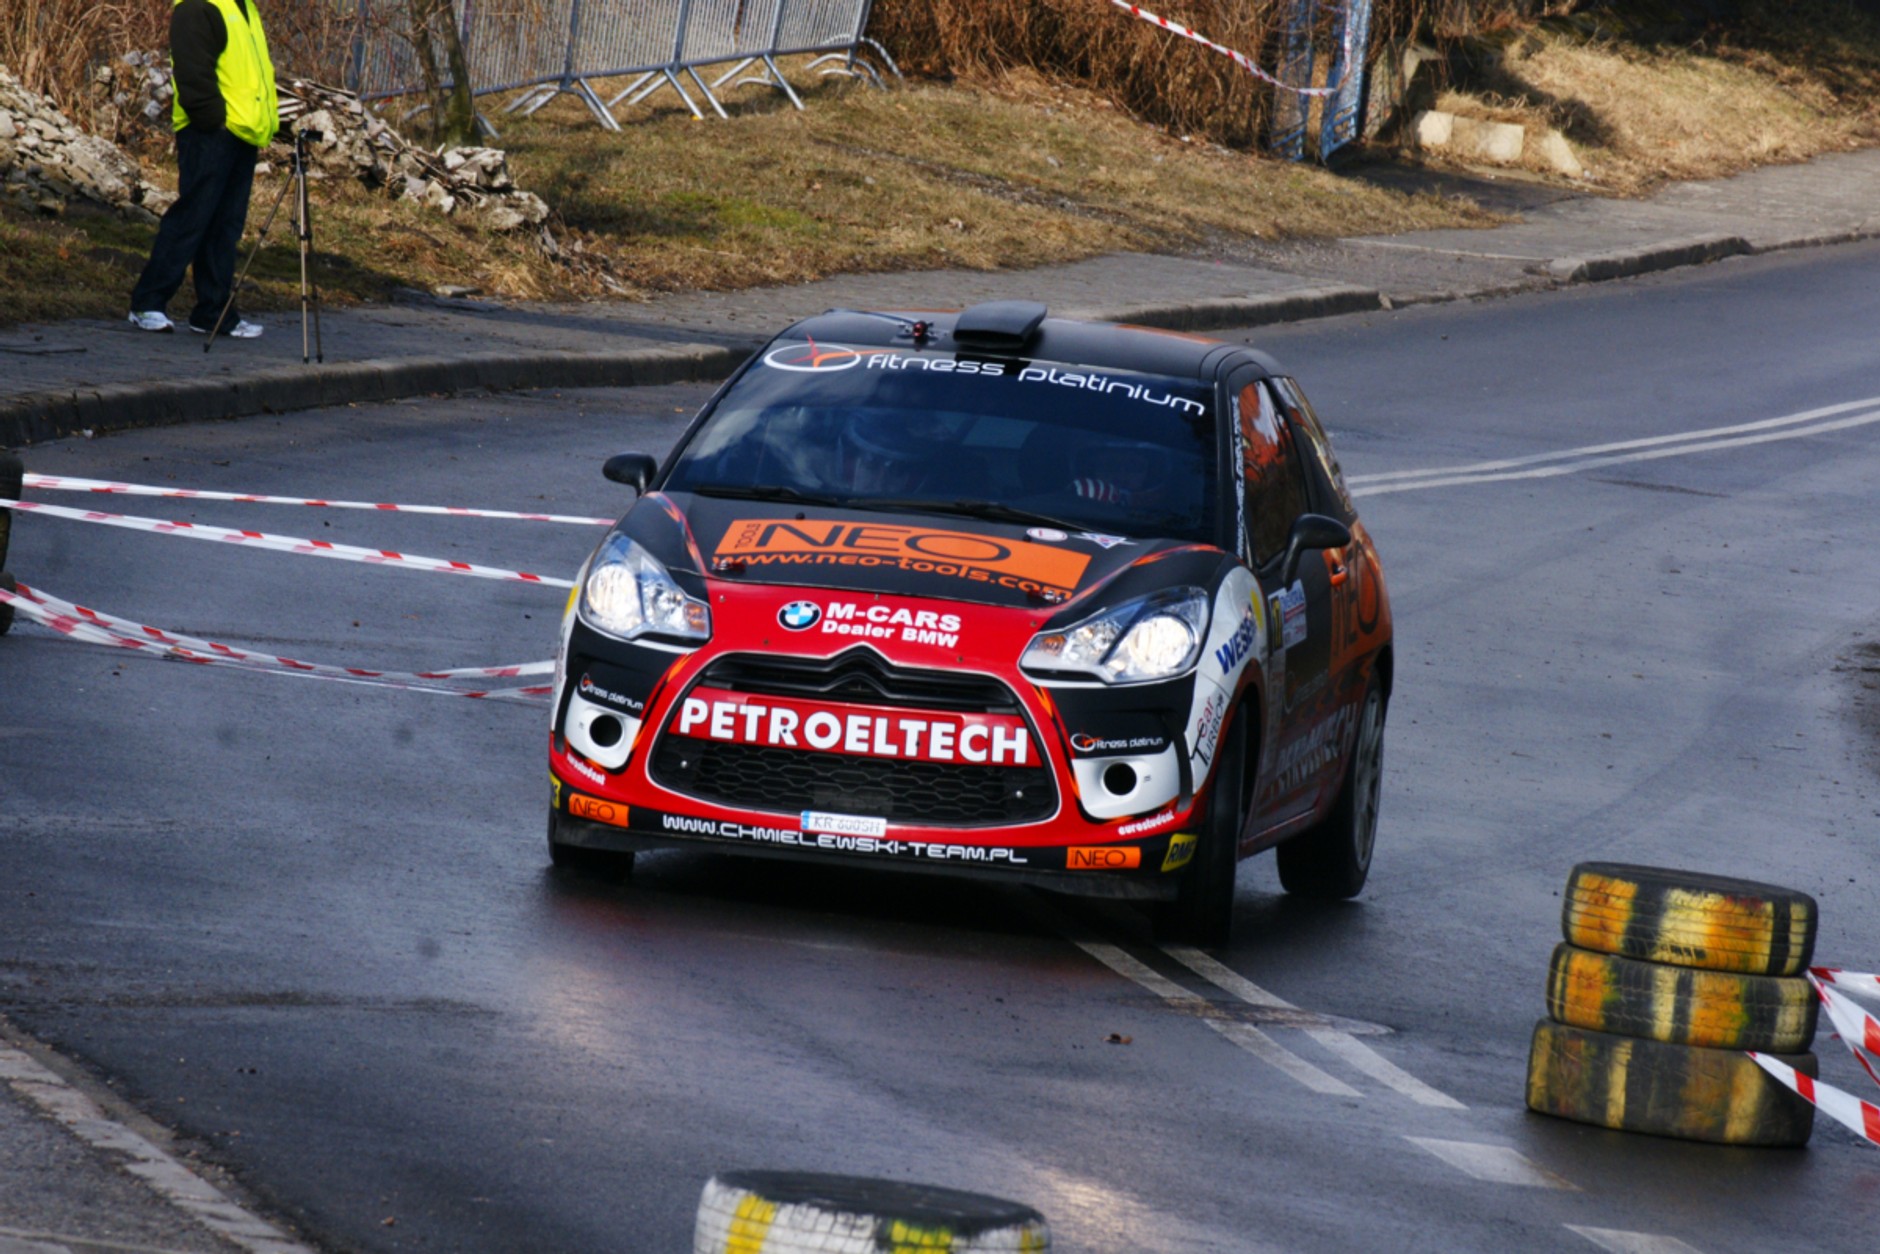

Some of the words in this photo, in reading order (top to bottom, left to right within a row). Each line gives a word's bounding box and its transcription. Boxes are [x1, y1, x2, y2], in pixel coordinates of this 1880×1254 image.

[866, 353, 1005, 376] fitness
[1018, 367, 1205, 416] platinium
[755, 523, 1012, 562] NEO
[821, 619, 895, 639] Dealer
[902, 627, 959, 649] BMW
[825, 602, 962, 633] M-CARS
[679, 697, 1028, 764] PETROELTECH
[573, 797, 616, 823] NEO
[663, 814, 1028, 864] WWW.CHMIELEWSKI-TEAM.PL
[1074, 849, 1127, 867] NEO
